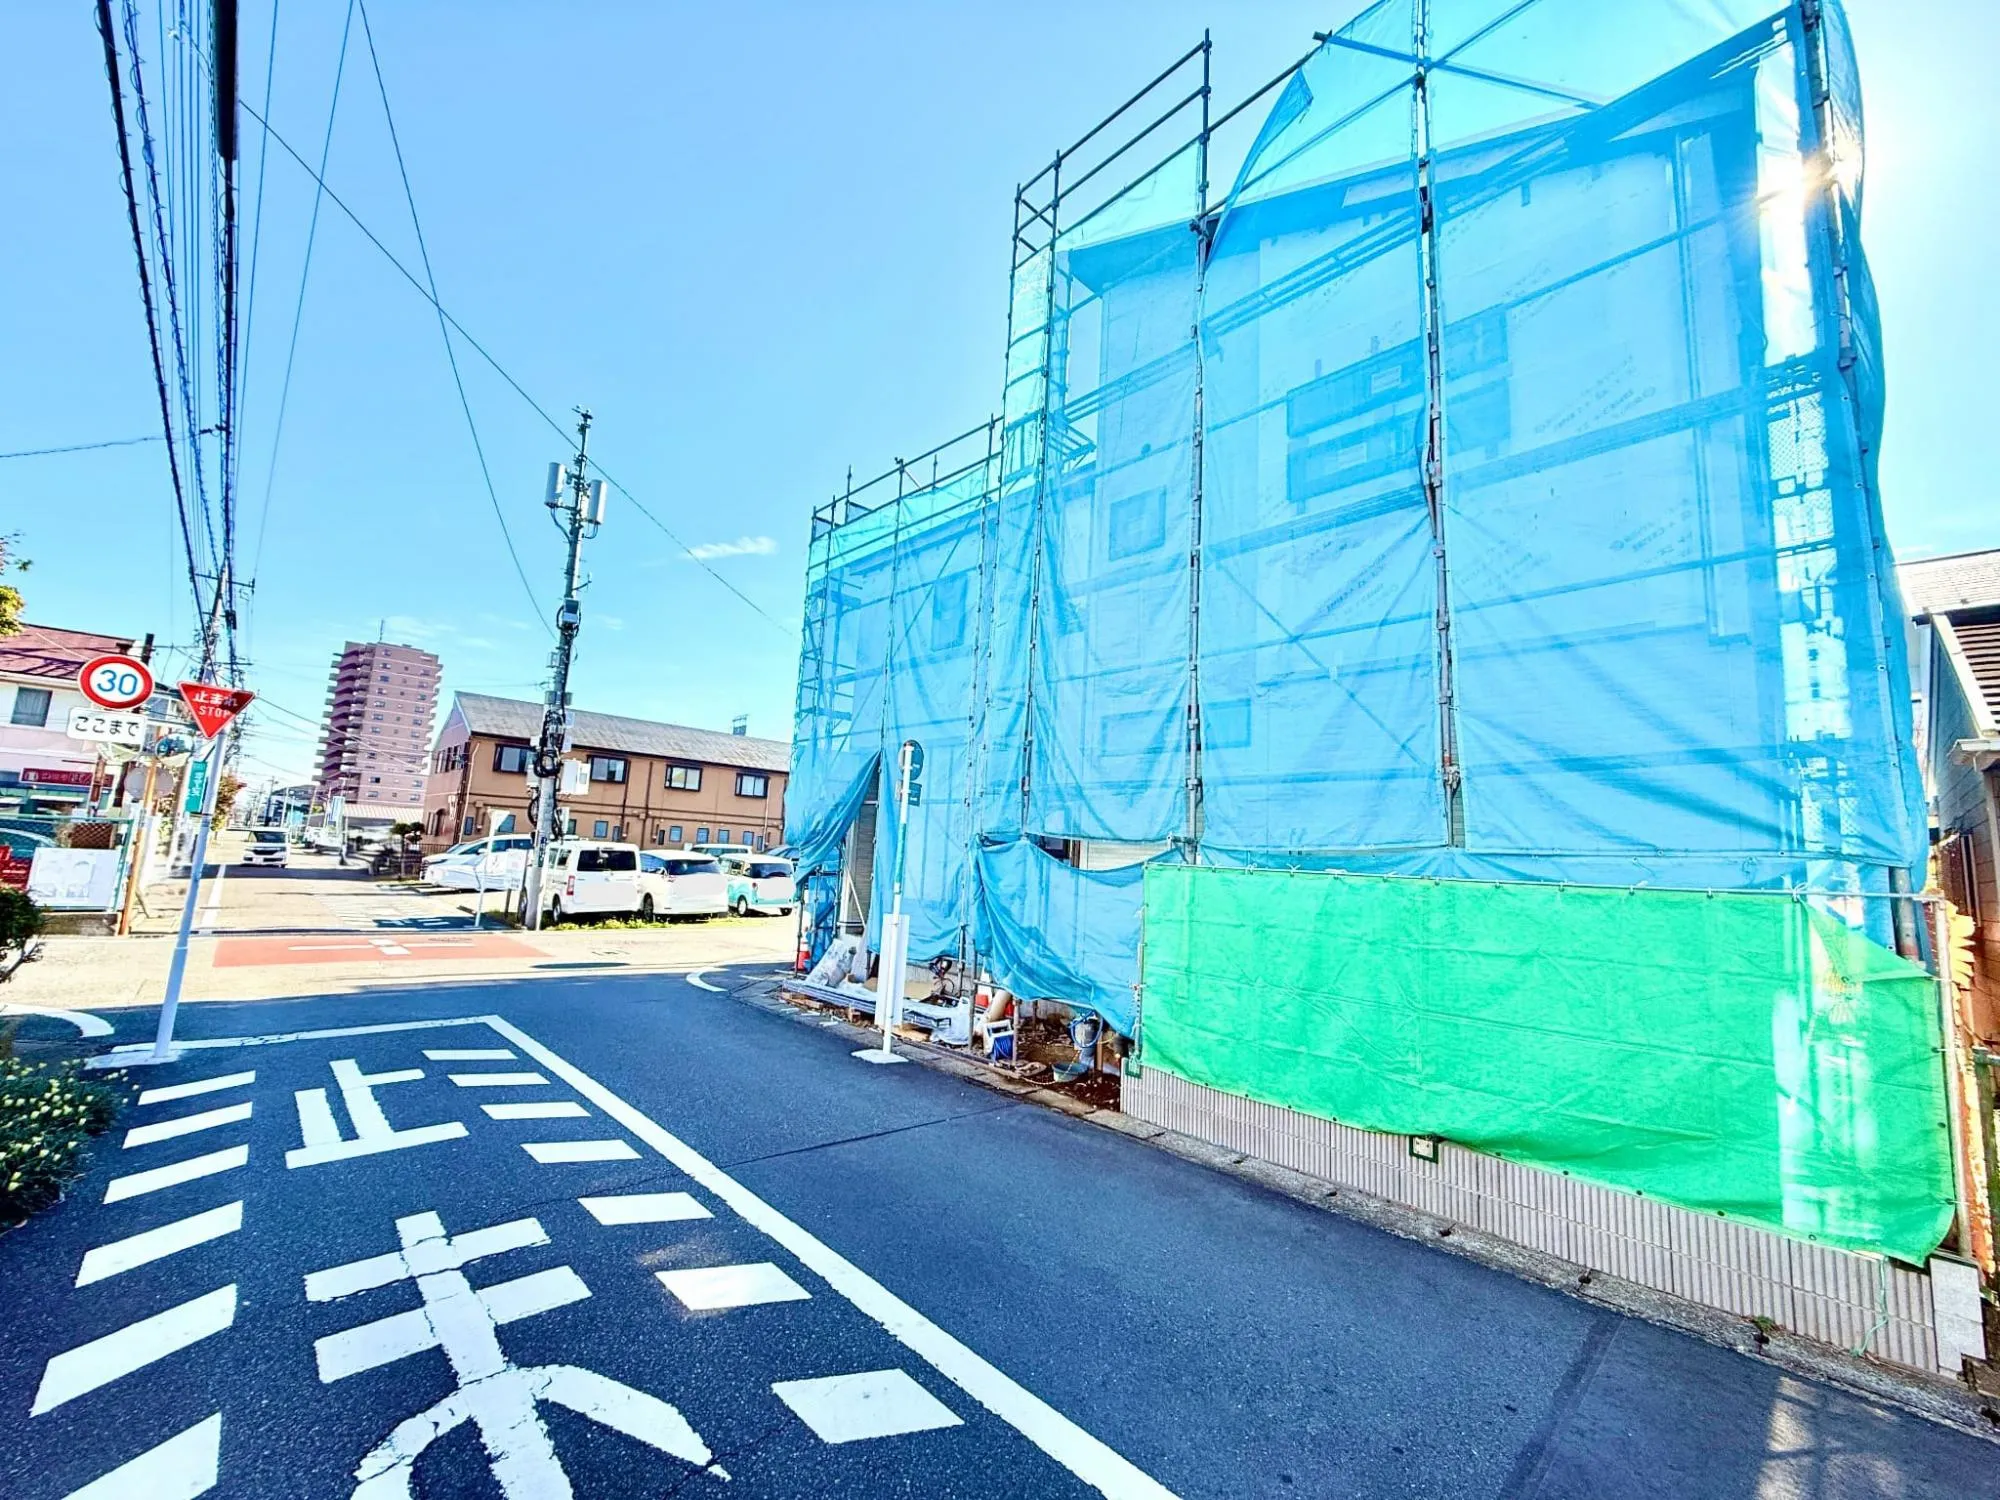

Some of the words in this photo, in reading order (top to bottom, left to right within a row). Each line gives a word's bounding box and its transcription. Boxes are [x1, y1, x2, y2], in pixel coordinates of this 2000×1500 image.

[96, 669, 138, 696] 30
[193, 690, 238, 707] 止まれ
[199, 704, 232, 719] STOP
[74, 715, 140, 737] ここまで
